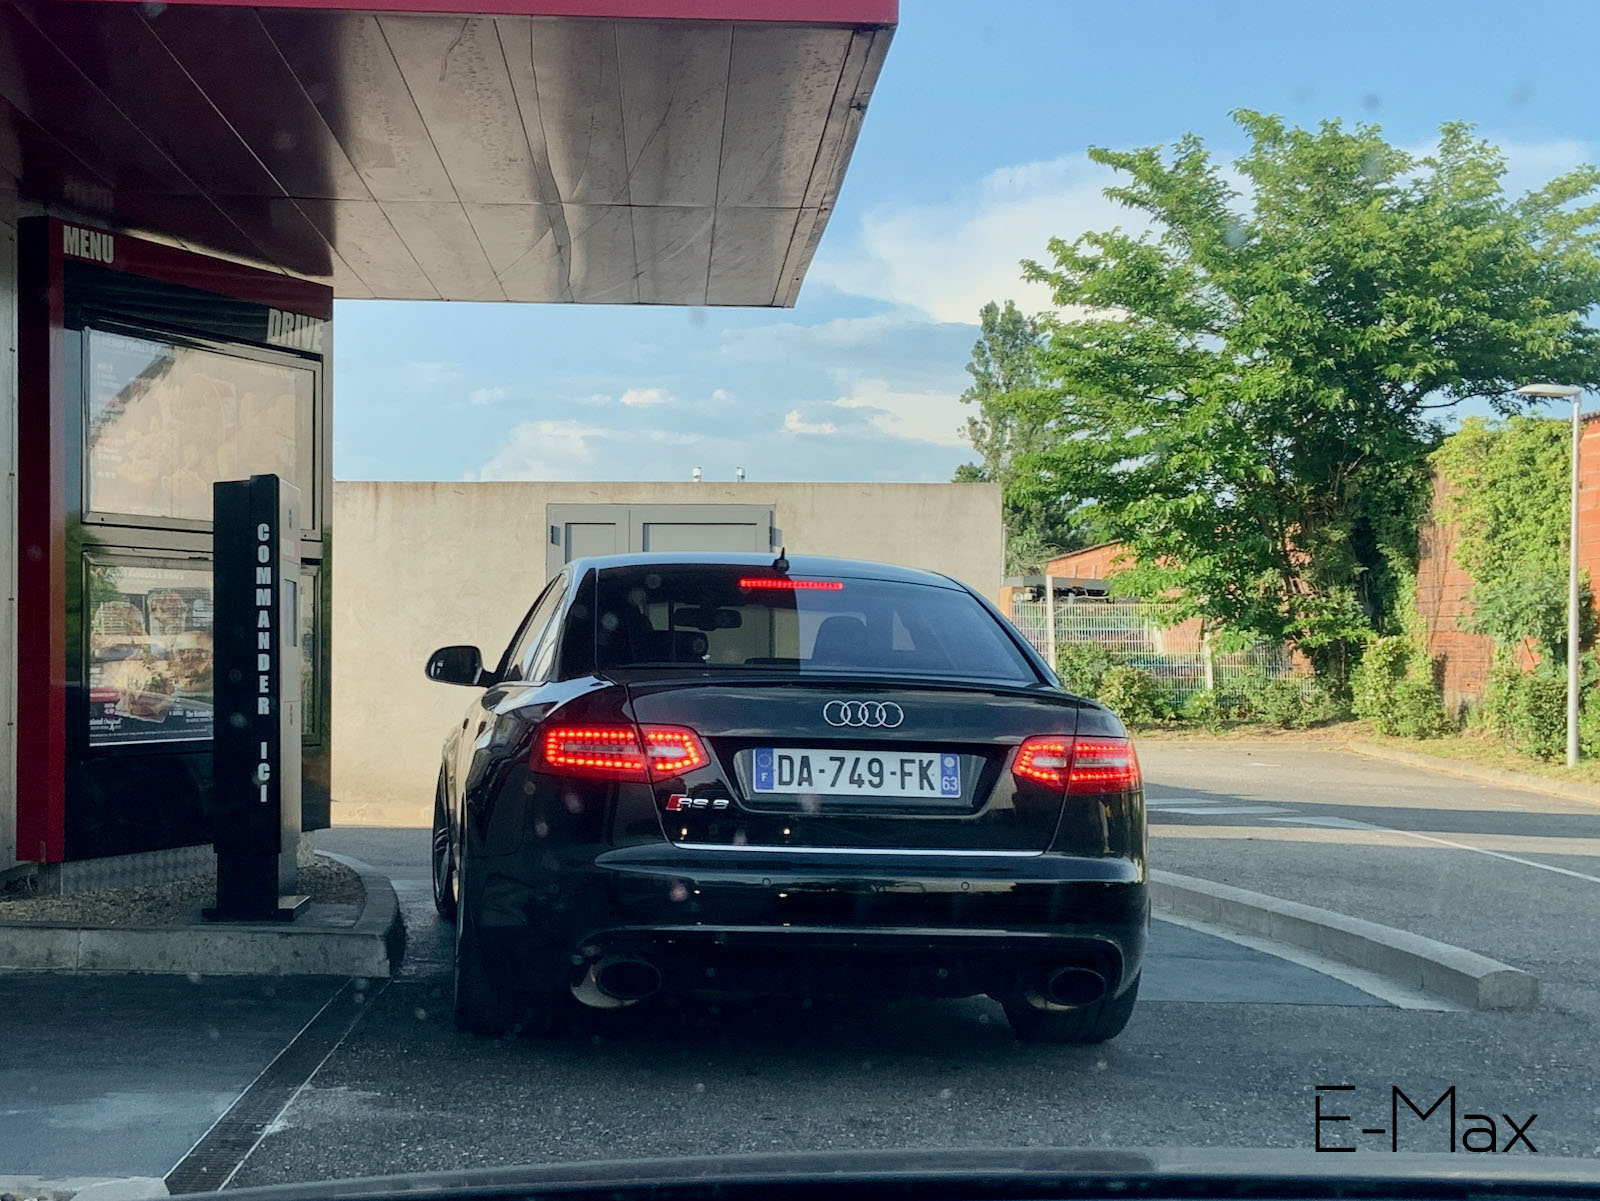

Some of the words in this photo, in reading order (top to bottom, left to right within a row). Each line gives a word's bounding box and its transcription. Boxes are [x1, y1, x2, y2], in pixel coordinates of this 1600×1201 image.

[63, 224, 114, 264] MENU
[267, 308, 324, 350] DRIVE
[255, 522, 272, 715] COMMANDER
[257, 741, 271, 803] ICI
[761, 772, 768, 782] F
[777, 754, 936, 791] DA-749-FK
[942, 776, 958, 791] 63
